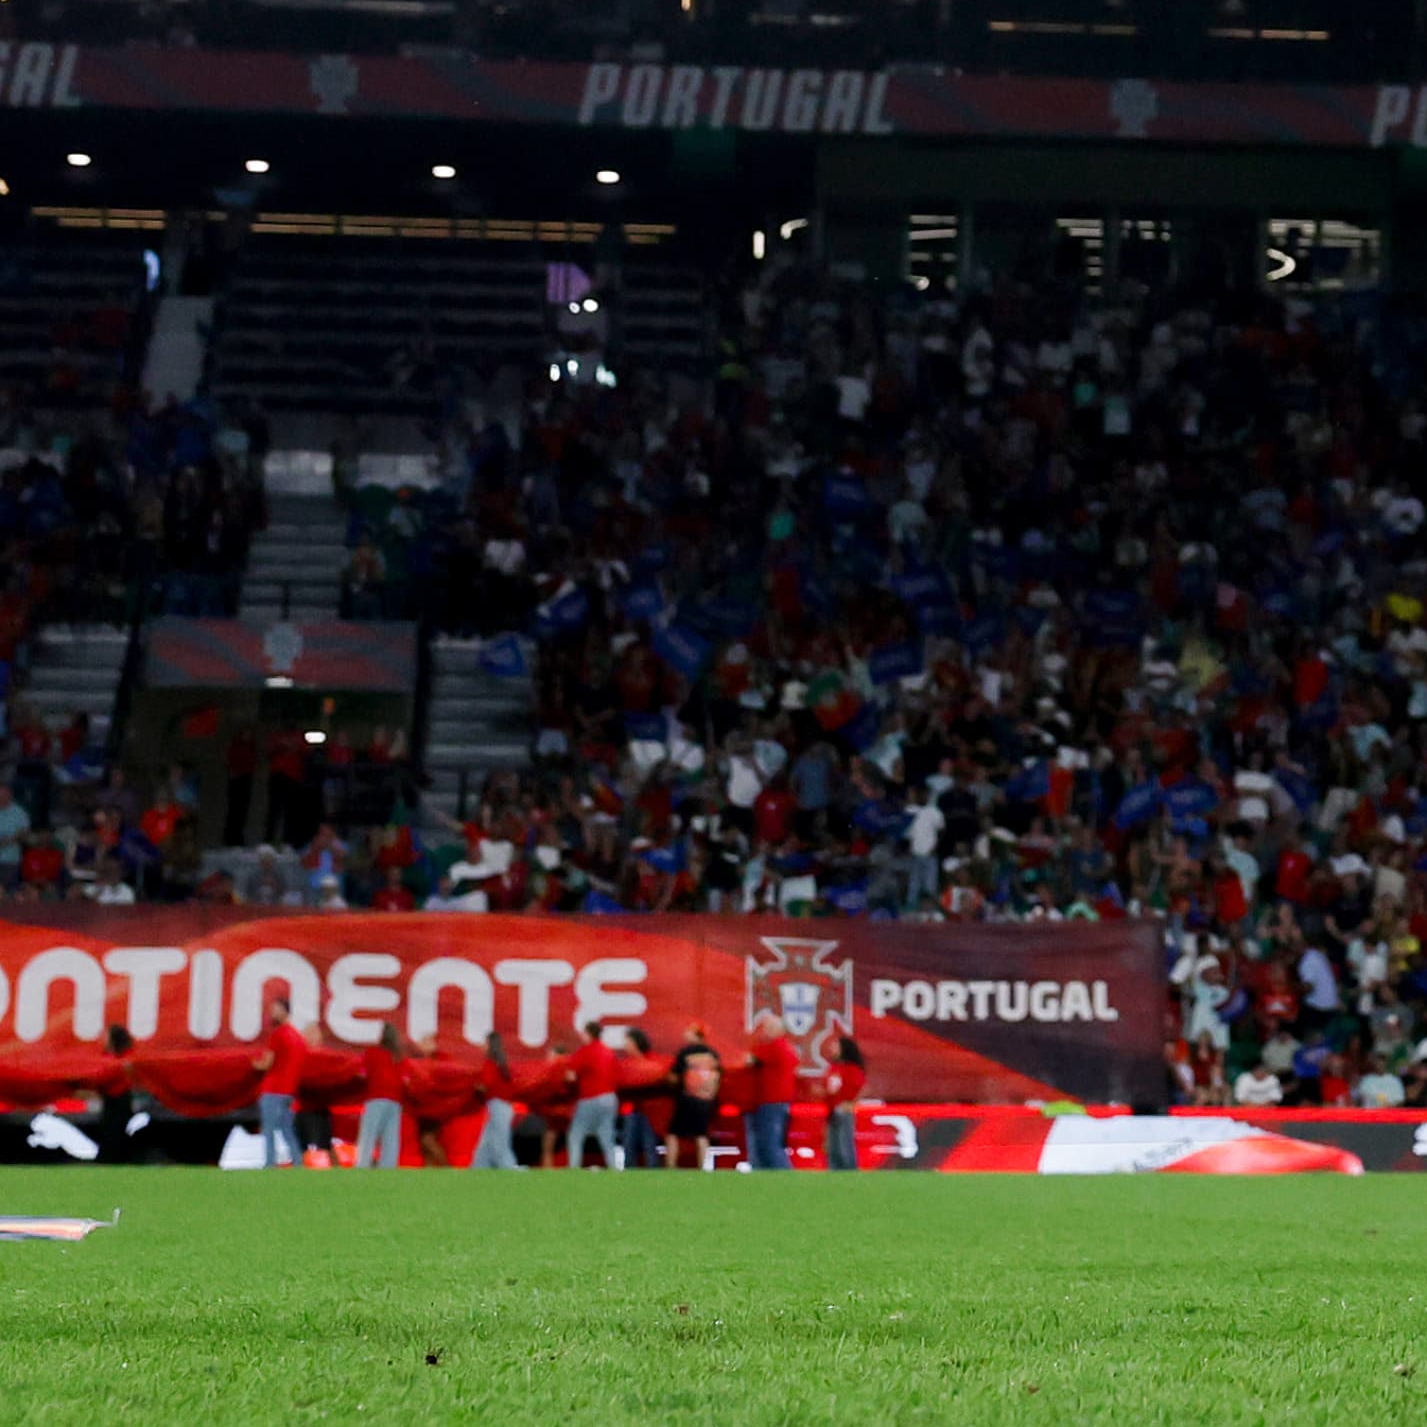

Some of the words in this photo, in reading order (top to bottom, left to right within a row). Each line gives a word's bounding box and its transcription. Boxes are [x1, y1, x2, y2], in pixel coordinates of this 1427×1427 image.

[577, 62, 895, 133] PORTUGAL
[0, 946, 648, 1049] NTINENTE
[870, 979, 1119, 1021] PORTUGAL
